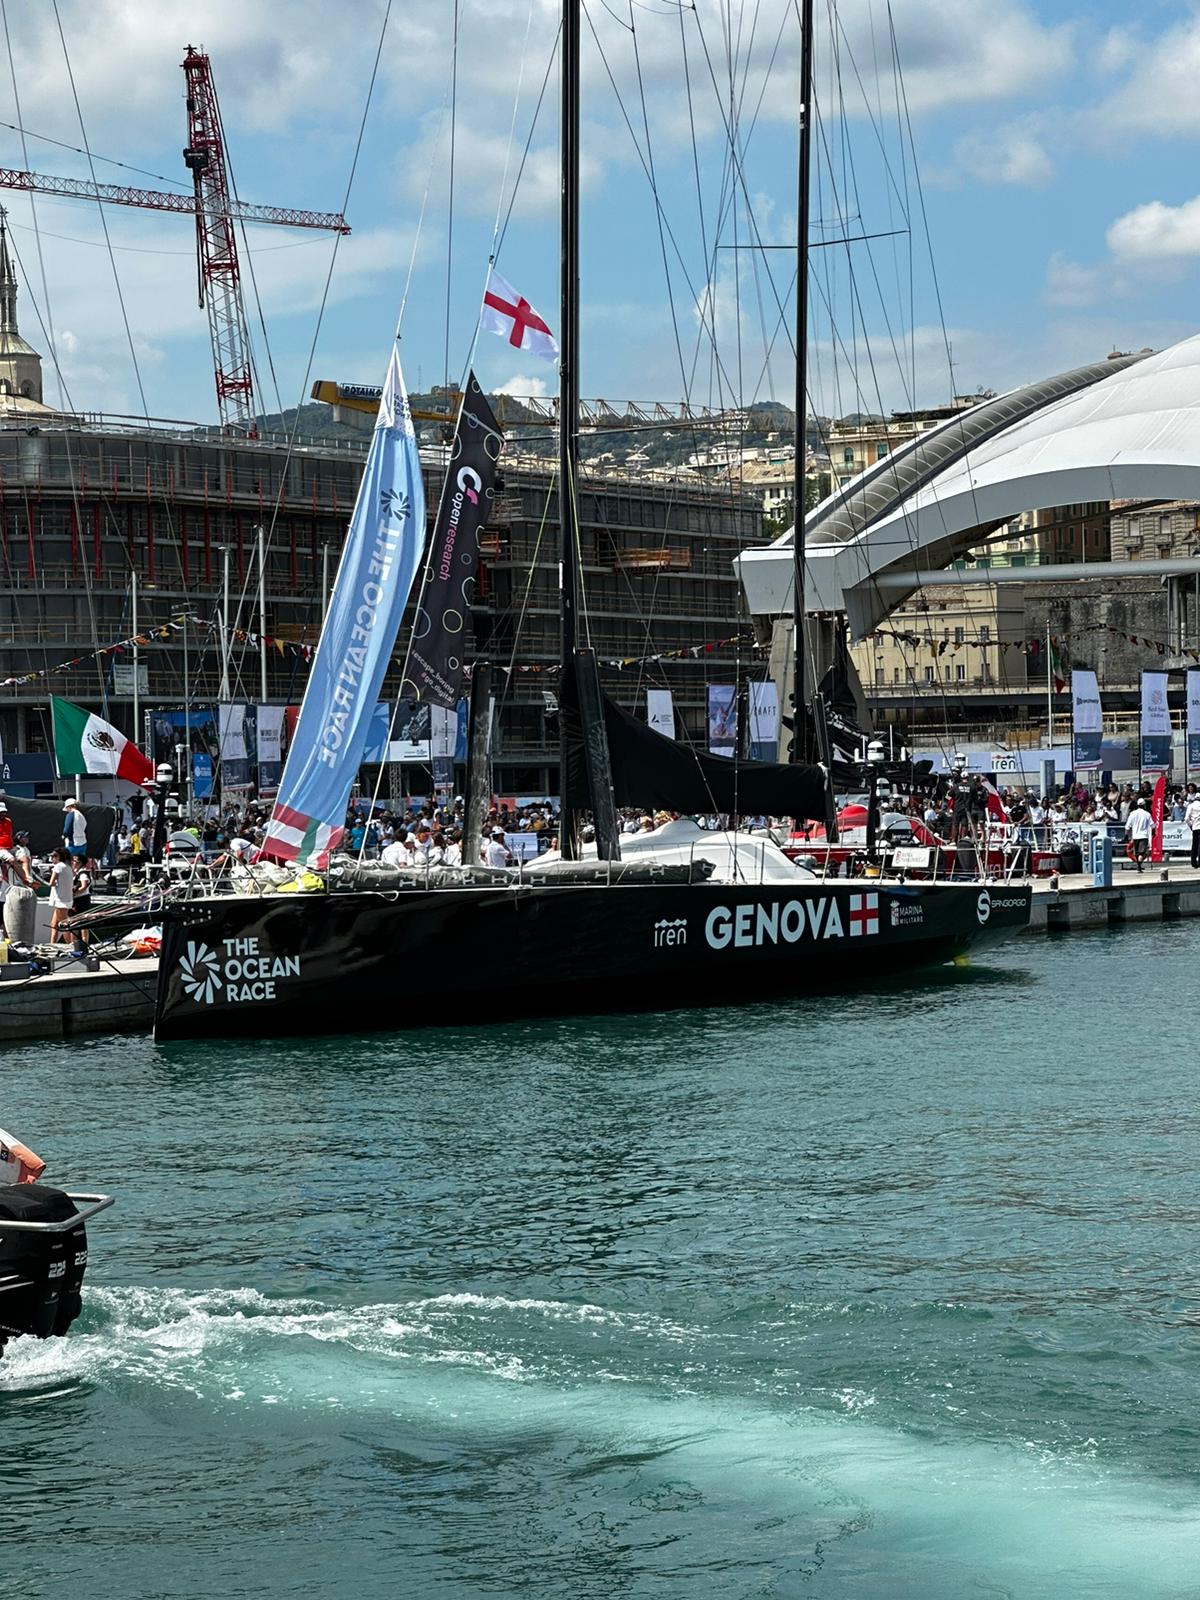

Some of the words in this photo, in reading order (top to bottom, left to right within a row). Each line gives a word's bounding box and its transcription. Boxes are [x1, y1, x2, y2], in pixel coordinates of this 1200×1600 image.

[344, 385, 375, 397] POTAIN
[439, 491, 464, 581] openresearch
[991, 758, 1017, 770] iren
[900, 905, 923, 916] MARINA
[704, 896, 845, 950] GENOVA
[654, 925, 687, 947] iren
[222, 937, 260, 957] THE
[224, 955, 301, 981] OCEAN
[226, 981, 277, 1002] RACE
